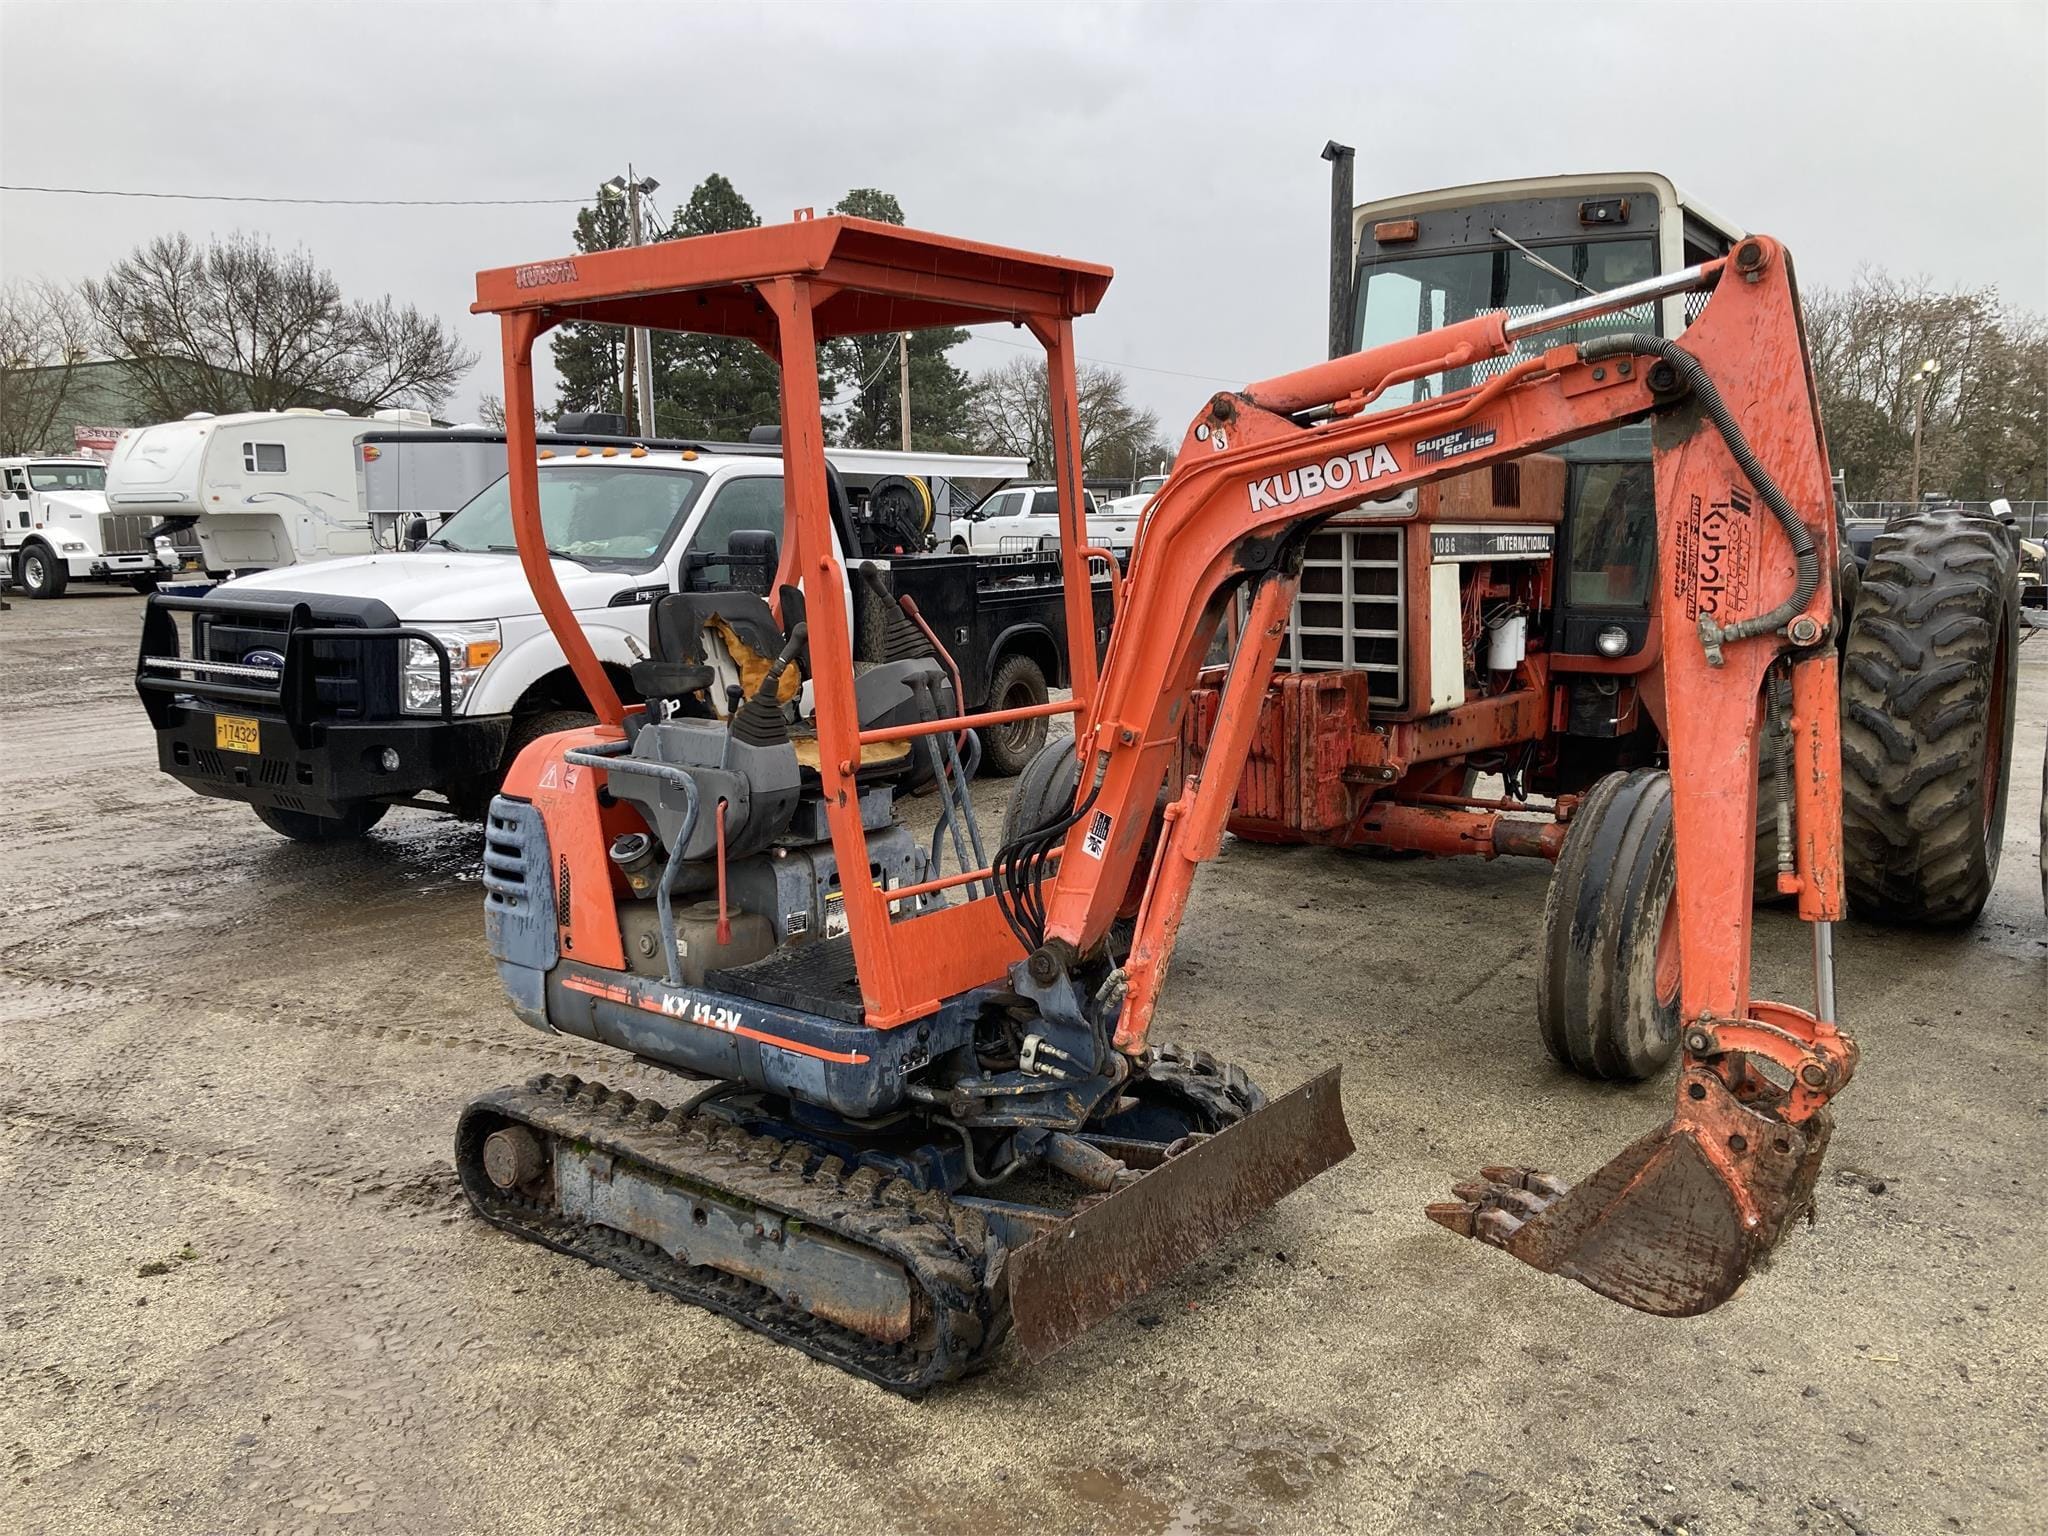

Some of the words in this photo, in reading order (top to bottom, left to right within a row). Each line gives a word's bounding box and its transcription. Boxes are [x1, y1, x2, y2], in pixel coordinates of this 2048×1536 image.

[515, 260, 578, 288] KUBOTA
[1415, 432, 1463, 455] Super
[1443, 432, 1495, 458] Series
[1247, 443, 1401, 513] KUBOTA
[1434, 537, 1456, 553] 1086
[1496, 535, 1550, 551] INTERNATIONAL
[1699, 503, 1730, 615] Kubota
